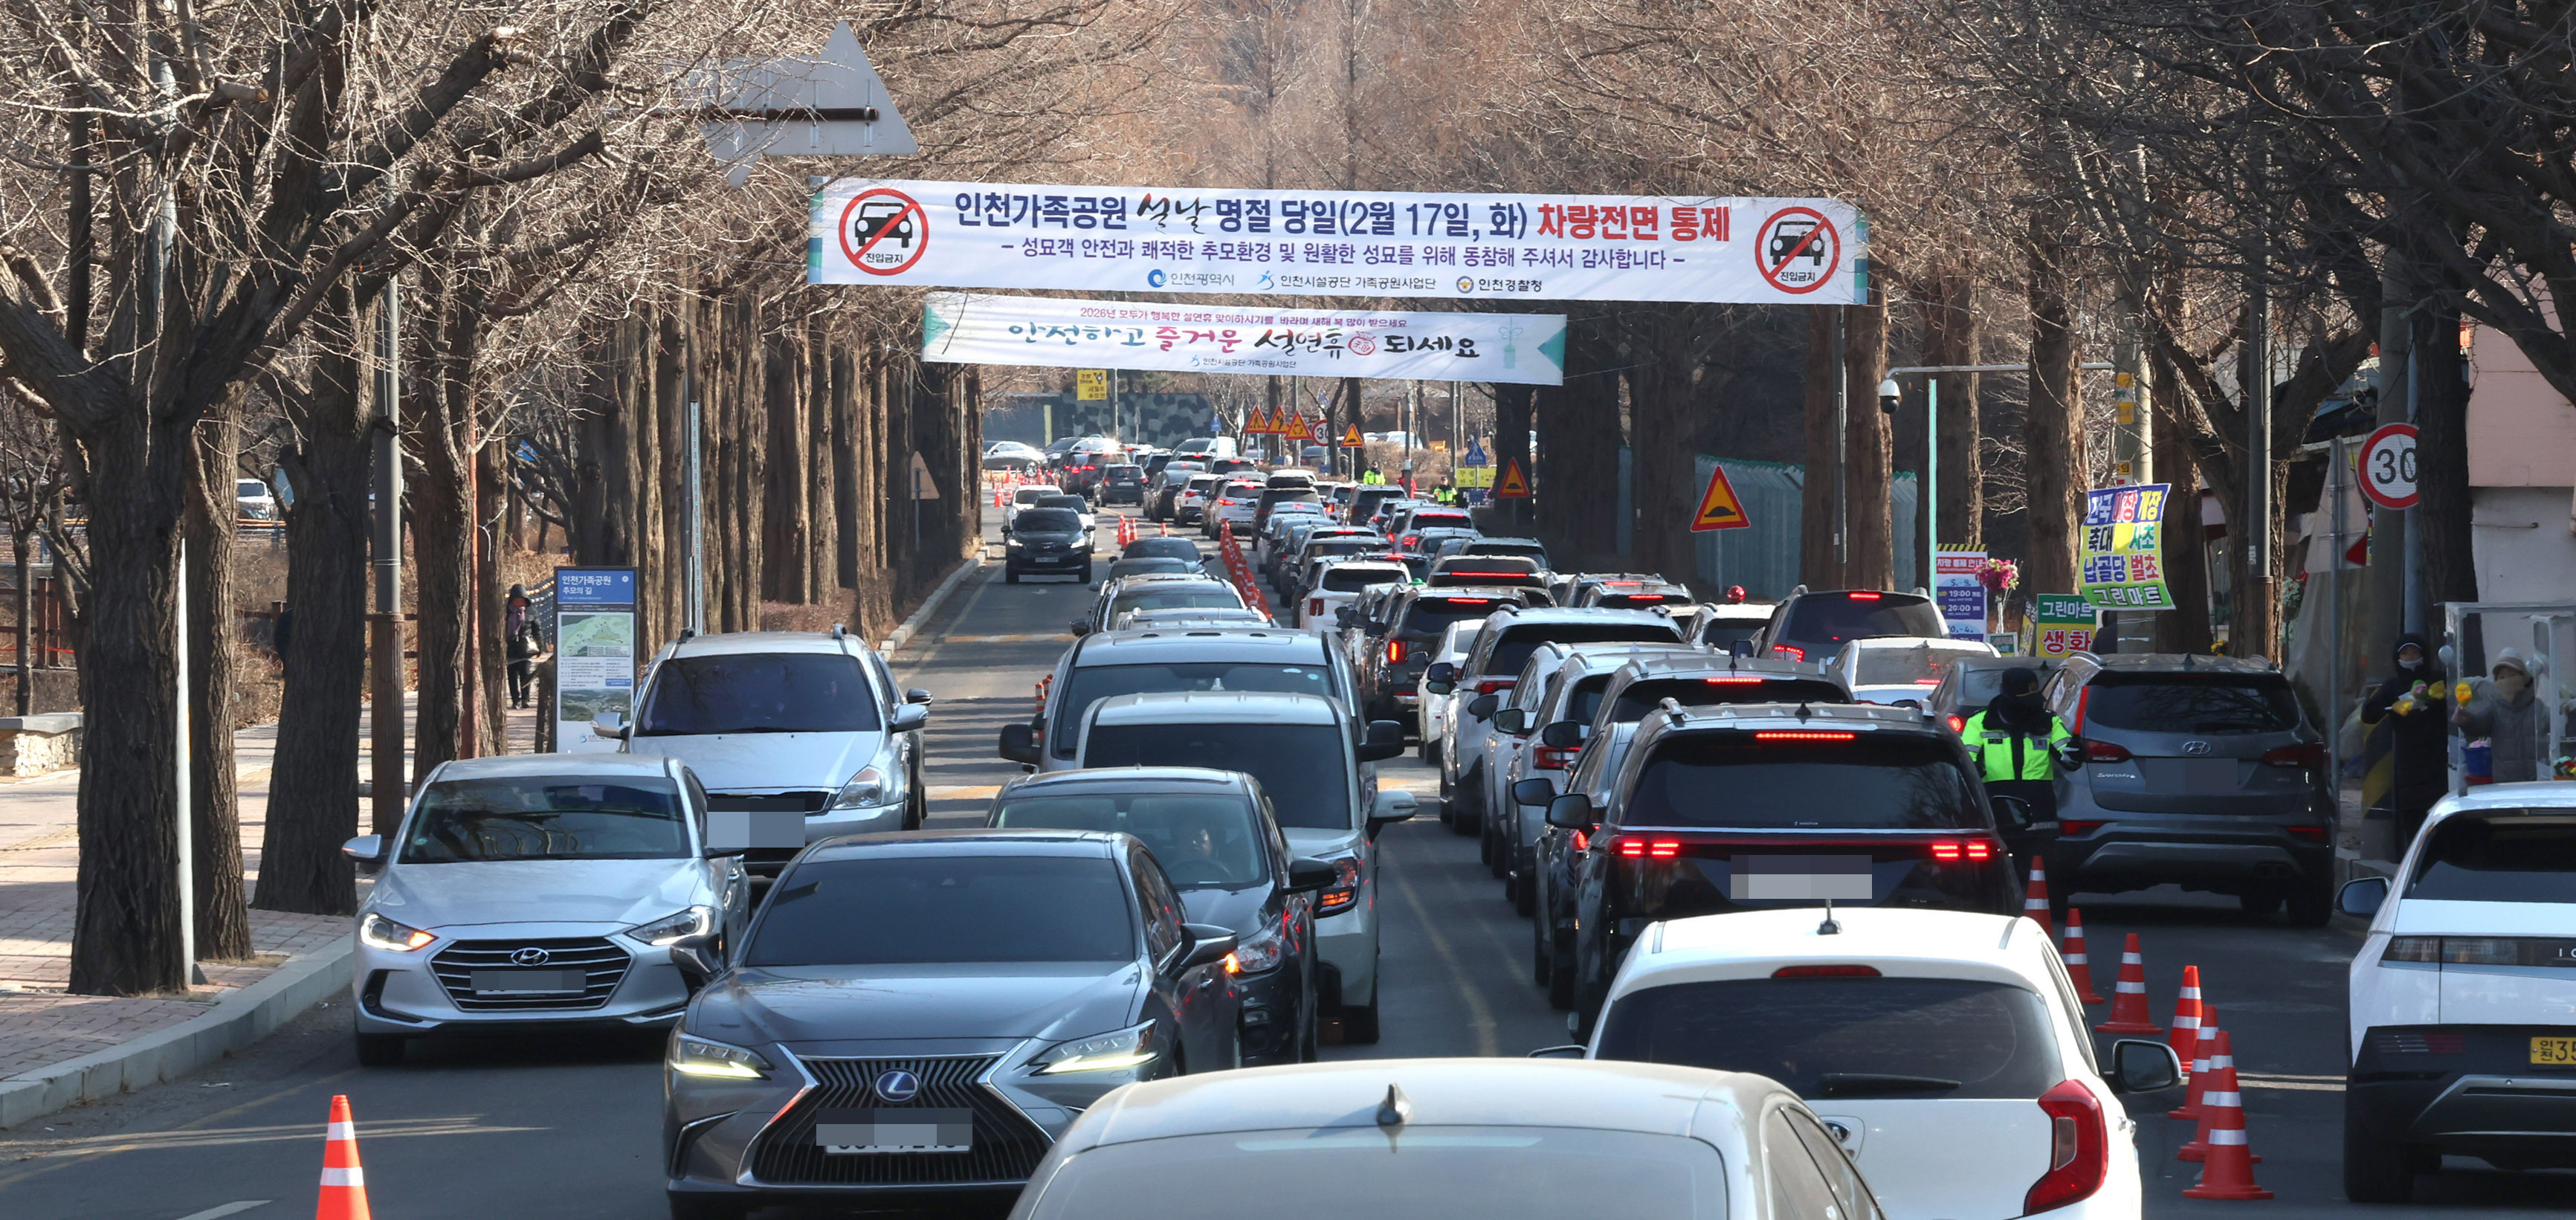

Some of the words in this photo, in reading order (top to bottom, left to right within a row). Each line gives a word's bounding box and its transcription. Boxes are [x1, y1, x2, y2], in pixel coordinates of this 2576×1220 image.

[955, 192, 1127, 230] 인천가족공원
[1137, 193, 1212, 234] 설날
[1216, 199, 1271, 233] 명절
[1281, 199, 1395, 236] 당일(2월
[1406, 203, 1479, 242] 17일,
[1489, 202, 1528, 239] 화)
[1537, 203, 1659, 241] 차량전면
[1670, 206, 1730, 242] 통제
[865, 253, 903, 263] 진입금지
[1021, 237, 1074, 258] 성묘객
[1082, 239, 1134, 259] 안전과
[1141, 239, 1194, 260] 쾌적한
[1201, 241, 1271, 262] 추모환경
[1279, 243, 1295, 262] 및
[1303, 242, 1355, 264] 원활한
[1363, 245, 1415, 265] 성묘를
[1421, 246, 1456, 265] 위해
[1463, 246, 1514, 267] 동참해
[1522, 248, 1573, 268] 주셔서
[1581, 249, 1666, 269] 감사합니다
[1171, 272, 1235, 286] 인천광역시
[1280, 275, 1351, 288] 인천시설공단
[1355, 277, 1436, 290] 가족공원사업단
[1479, 279, 1543, 292] 인천경찰청
[1780, 271, 1816, 283] 진입금지
[1080, 307, 1116, 319] 2026년
[1119, 309, 1148, 320] 모두가
[1151, 310, 1181, 322] 행복한
[1184, 312, 1213, 323] 설연휴
[1216, 314, 1274, 326] 맞이하시기를
[1279, 316, 1308, 326] 바라며
[1311, 317, 1331, 327] 새해
[1346, 318, 1365, 328] 많이
[1369, 319, 1407, 328] 받으세요
[1009, 322, 1146, 346] 안전하고
[1155, 326, 1242, 354] 즐거운
[1254, 328, 1346, 360] 설연휴
[1384, 335, 1480, 358] 되세요
[1203, 357, 1245, 367] 인천시설공단
[2375, 448, 2416, 484] 30
[2087, 493, 2113, 524] 전국
[2112, 490, 2137, 523] 이장
[2089, 526, 2114, 552] 축대
[2128, 524, 2155, 550] 사초
[2084, 555, 2126, 584] 납골당
[2131, 554, 2160, 582] 벌초
[562, 575, 611, 586] 인천가족공원
[585, 587, 593, 595] 길
[2093, 585, 2163, 607] 그린마트
[2041, 601, 2093, 619] 그린마트
[2043, 630, 2092, 653] 생화
